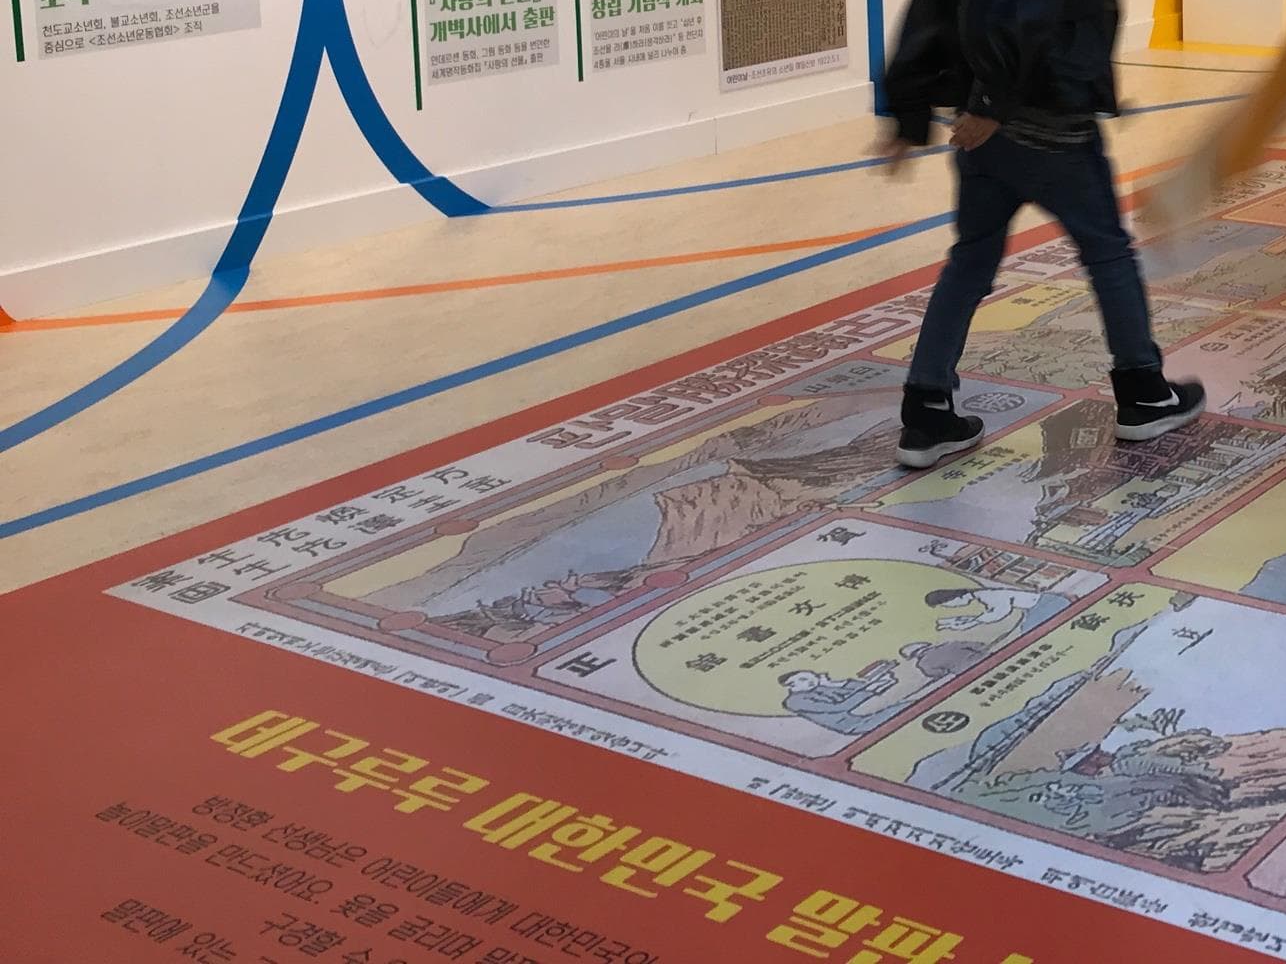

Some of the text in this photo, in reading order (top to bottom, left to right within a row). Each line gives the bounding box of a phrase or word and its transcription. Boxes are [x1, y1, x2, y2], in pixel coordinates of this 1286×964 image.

[42, 2, 220, 38] 천도교소년회, 불교소년회, 조선소년군을
[43, 37, 85, 55] 중심으로
[184, 20, 203, 34] 조직
[429, 5, 555, 42] 개벽사에서 출판
[209, 707, 494, 815] 데구루루
[463, 792, 785, 924] 대한민국
[95, 801, 484, 961] 놀이말판을 만드셨어요. 윷을 굴리며
[192, 794, 276, 832] 방정환
[261, 822, 367, 868] 선생님은
[360, 856, 520, 925] 어린이들에게
[100, 898, 194, 944] 말판에
[259, 912, 347, 958] 구경할
